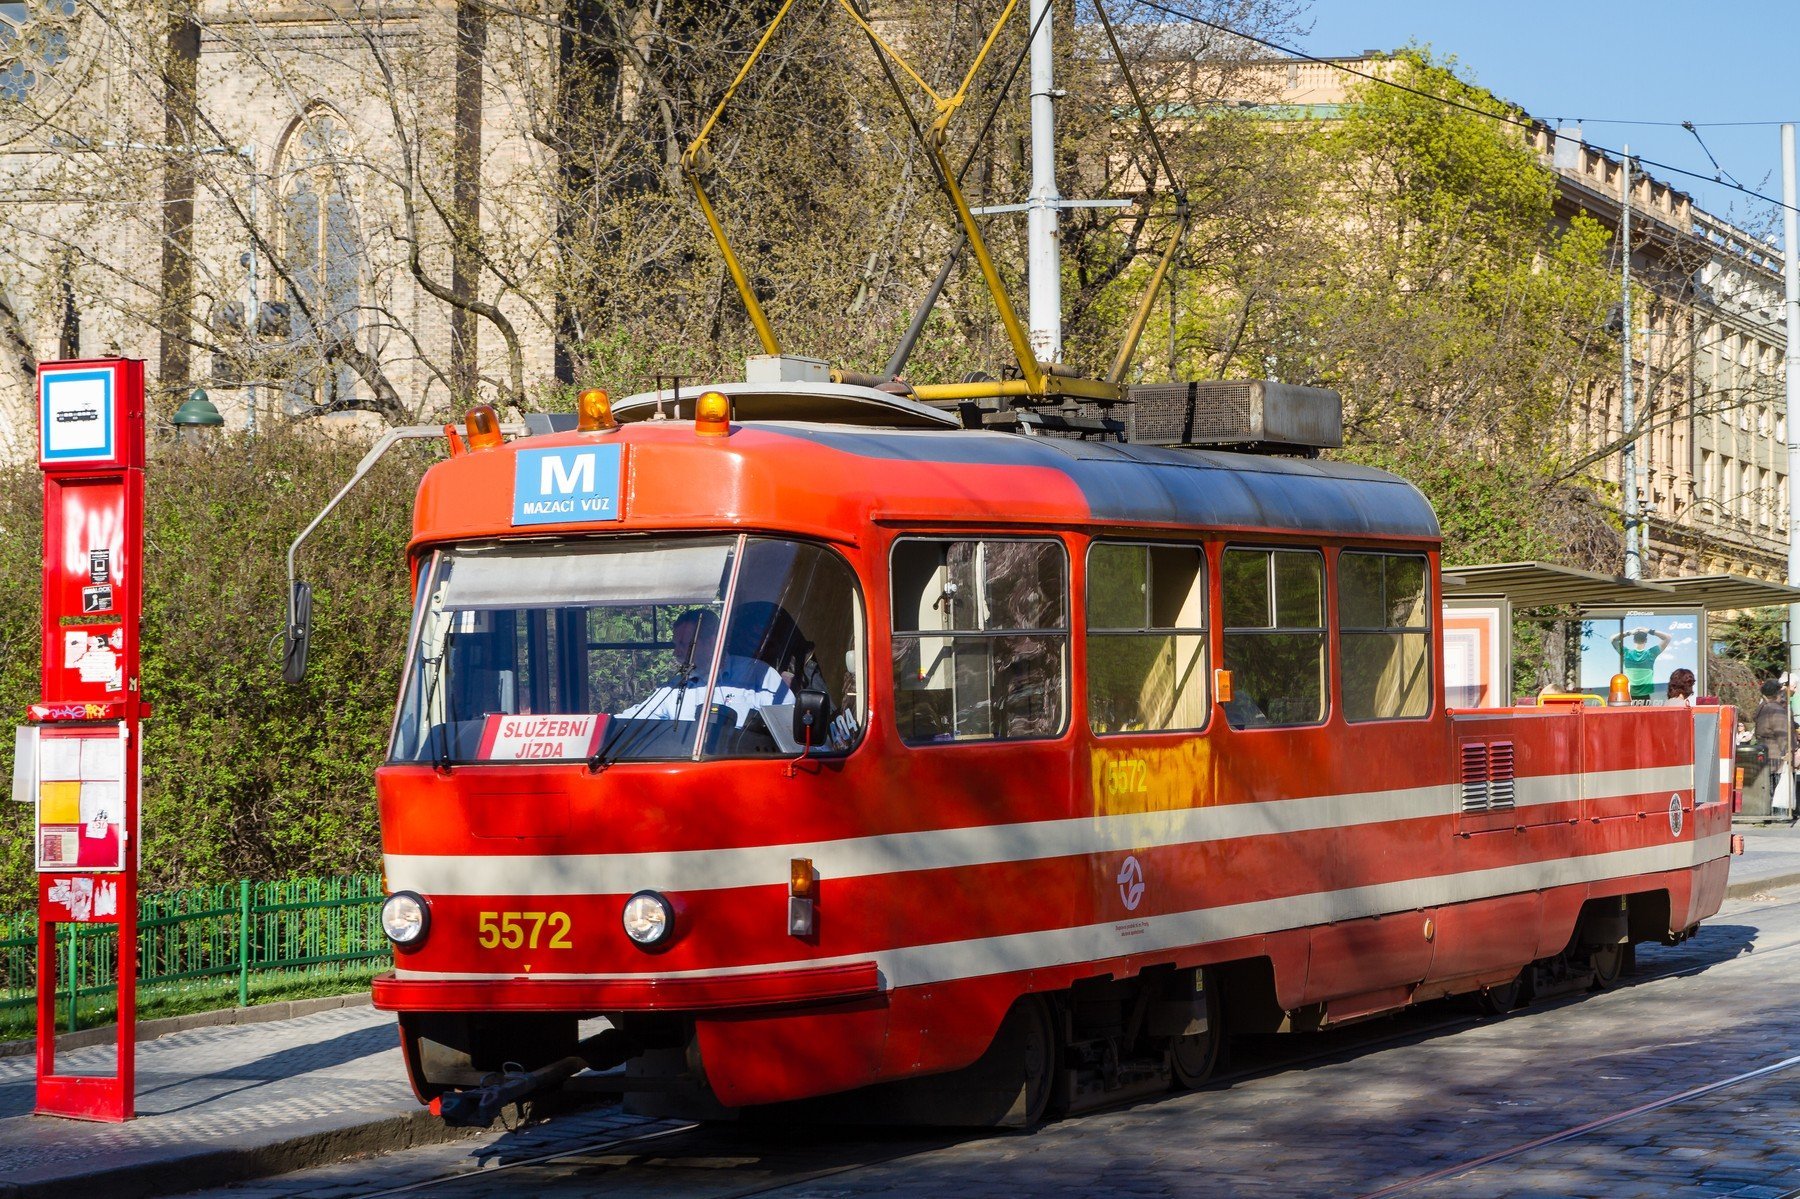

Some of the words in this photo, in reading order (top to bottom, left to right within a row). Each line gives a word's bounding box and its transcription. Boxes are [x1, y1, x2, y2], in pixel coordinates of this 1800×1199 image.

[540, 453, 596, 495] M
[523, 496, 575, 515] MAZACÍ
[503, 717, 590, 738] SLUŽEBNÍ
[515, 740, 563, 759] JÍZDA
[1108, 759, 1147, 794] 5572
[479, 911, 573, 949] 5572
